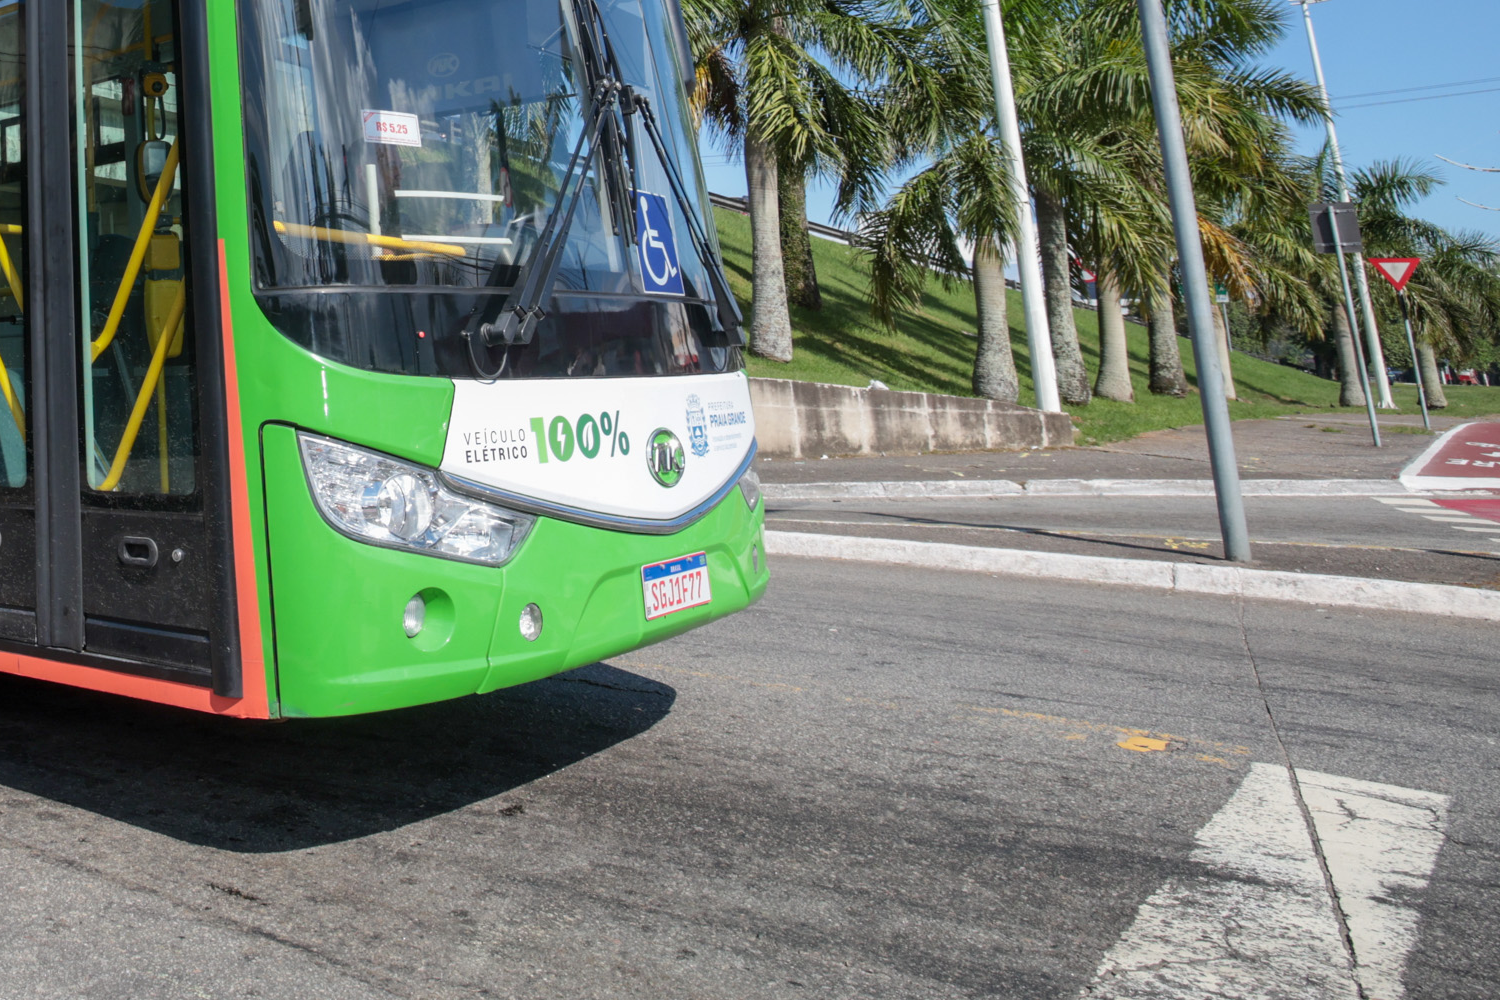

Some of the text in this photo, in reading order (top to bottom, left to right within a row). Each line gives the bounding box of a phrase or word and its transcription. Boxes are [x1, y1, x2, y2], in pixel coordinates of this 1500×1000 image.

[375, 121, 408, 135] R$ 5,25
[710, 411, 746, 427] PRAIA GRANDE
[463, 410, 630, 464] VEÍCULO 100%
[465, 446, 528, 464] ELÉTRICO
[651, 570, 701, 611] SGJ1F77
